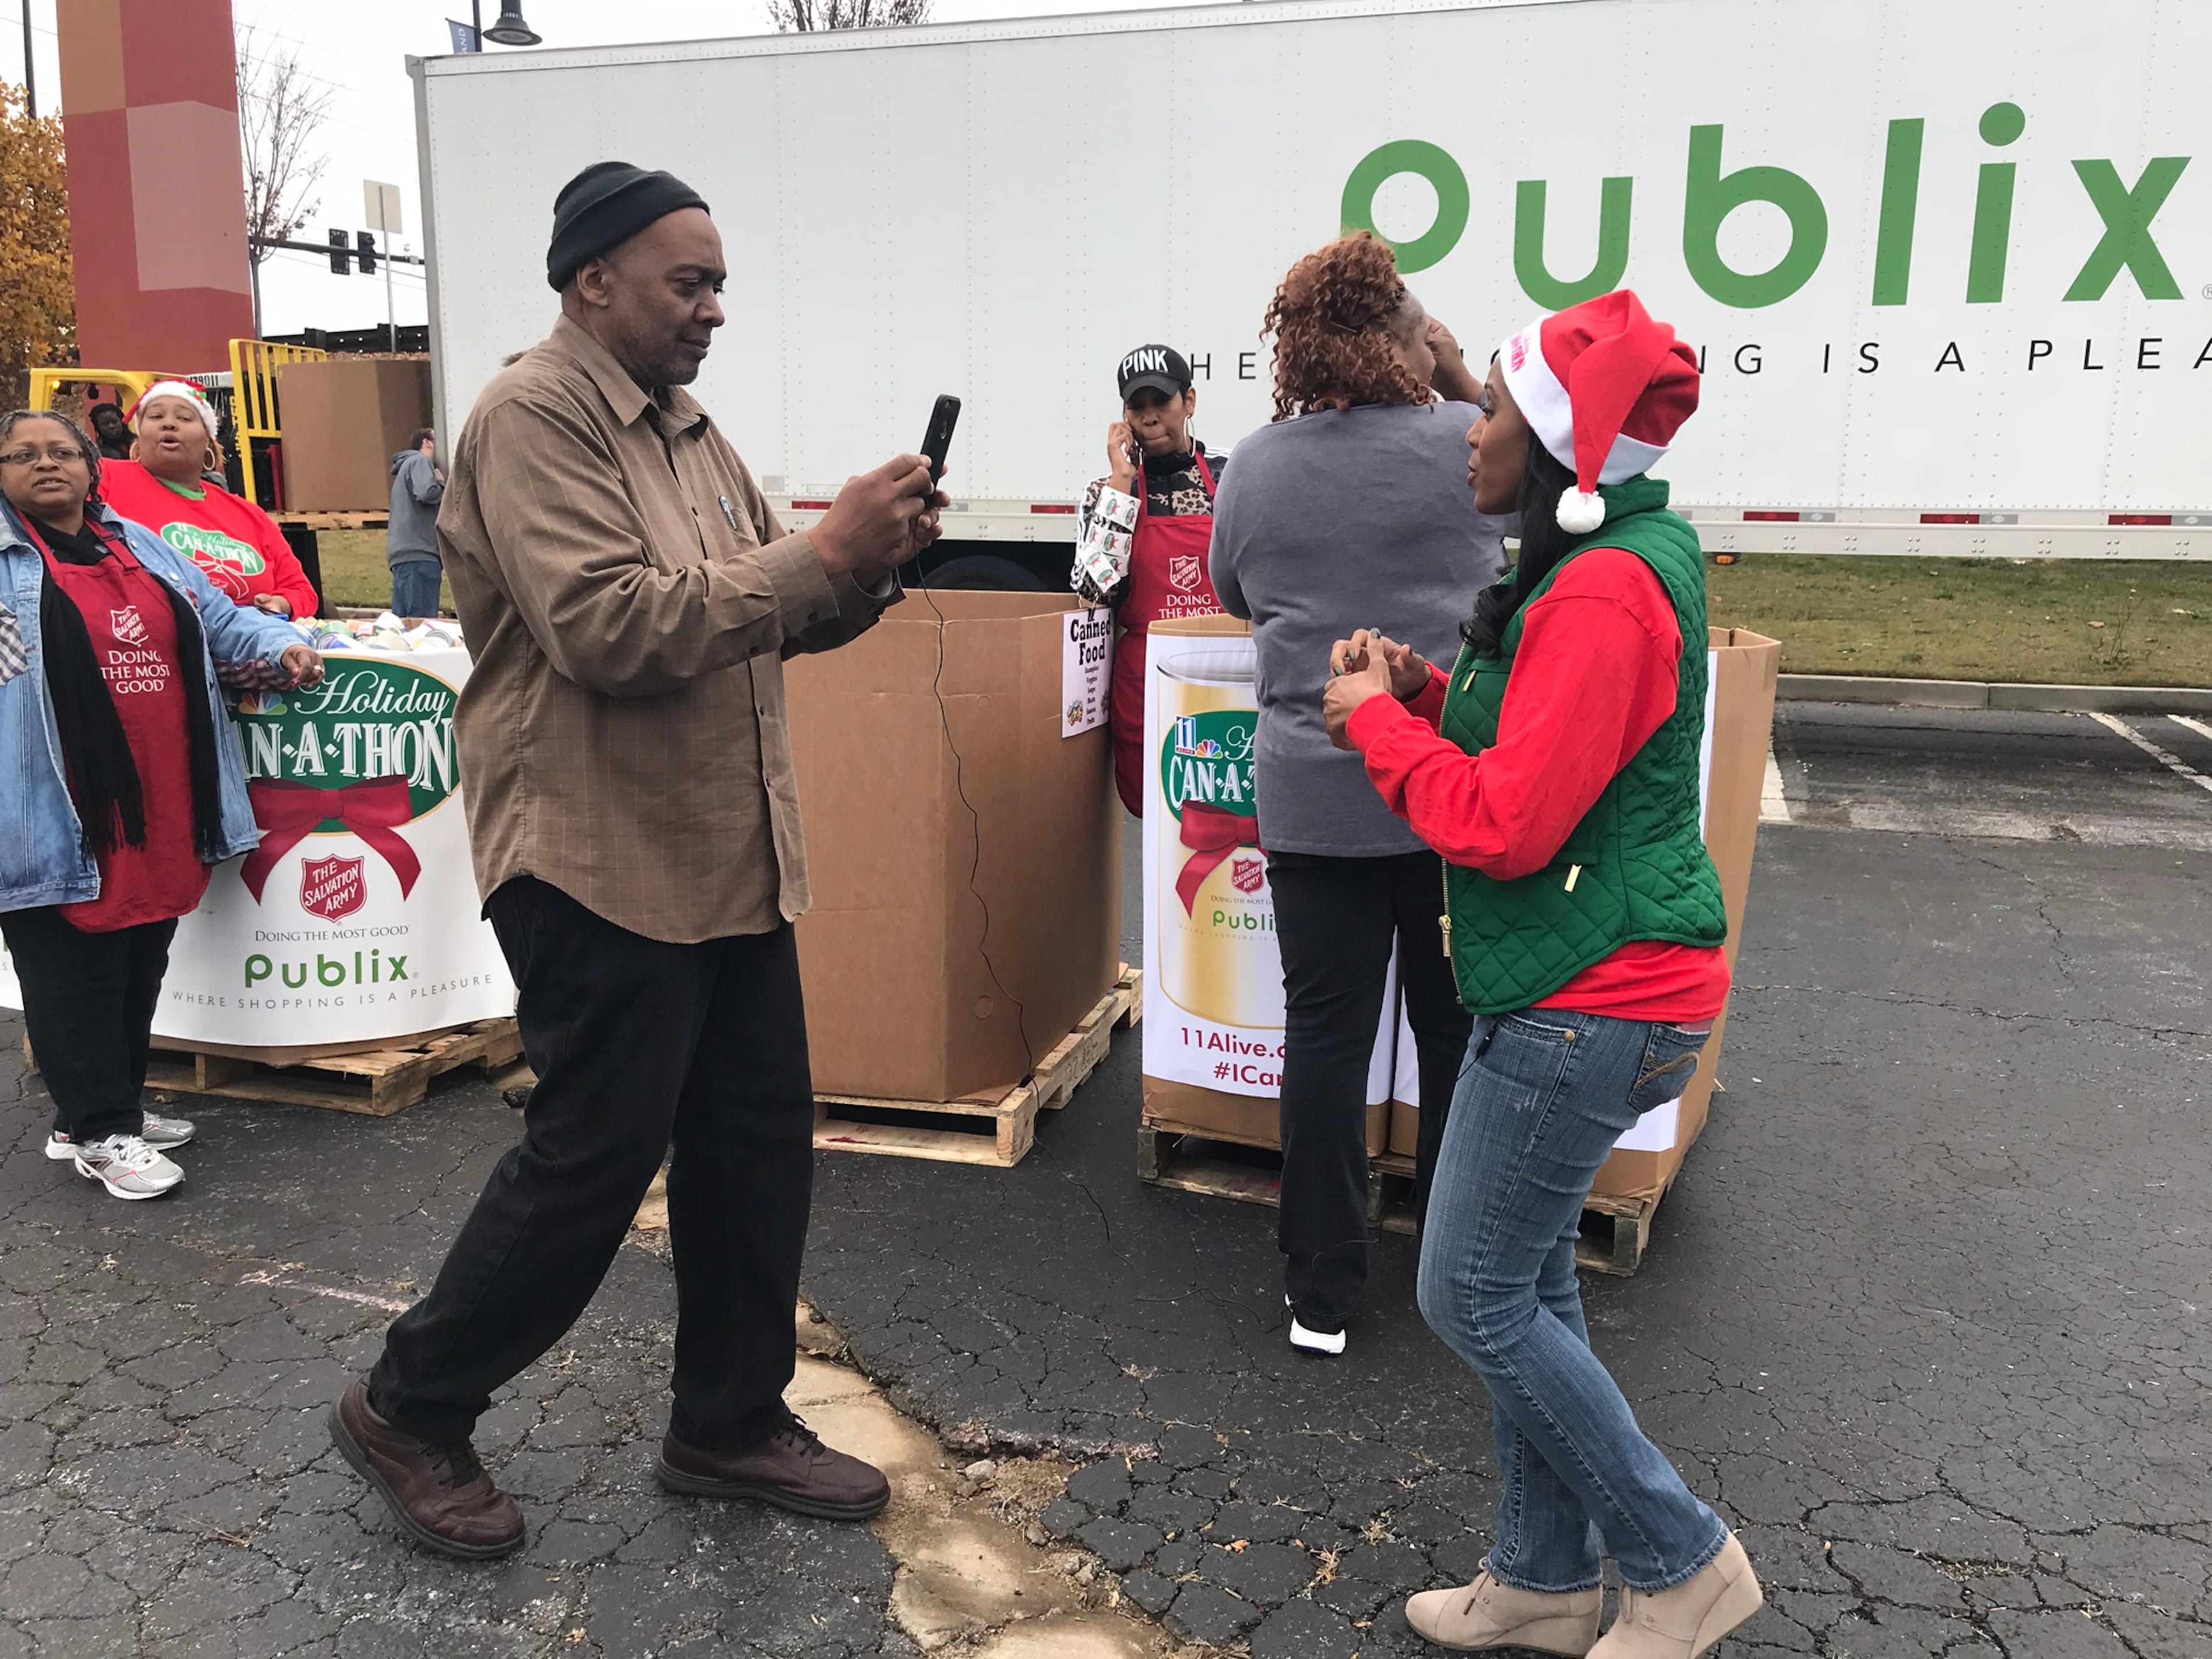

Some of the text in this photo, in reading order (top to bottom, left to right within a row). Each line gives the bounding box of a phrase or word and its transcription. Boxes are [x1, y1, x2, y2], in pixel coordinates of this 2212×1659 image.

[1340, 101, 2192, 312] Publix
[1123, 349, 1168, 380] PINK
[1823, 342, 1880, 373] IS
[1935, 341, 1965, 372] A
[1175, 559, 1187, 571] THE
[1182, 570, 1196, 587] ARMY
[1166, 594, 1211, 607] DOING
[118, 610, 131, 624] THE
[1158, 606, 1221, 619] THE MOST
[1070, 613, 1111, 642] Canned
[1079, 638, 1105, 665] Food
[100, 664, 170, 679] THE MOST
[116, 680, 164, 694] GOOD
[294, 670, 450, 725] Holiday
[1176, 717, 1195, 749] 11
[313, 861, 338, 884] THE
[1233, 863, 1260, 885] SALVATION
[1237, 862, 1249, 873] THE
[305, 863, 358, 907] SALVATION
[1243, 874, 1260, 890] ARMY
[324, 882, 358, 915] ARMY
[1212, 910, 1274, 931] Publi
[255, 925, 409, 942] DOING THE MOST GOOD
[245, 949, 408, 988] Publix
[173, 974, 493, 1009] WHERE SHOPPING IS A PLEASURE
